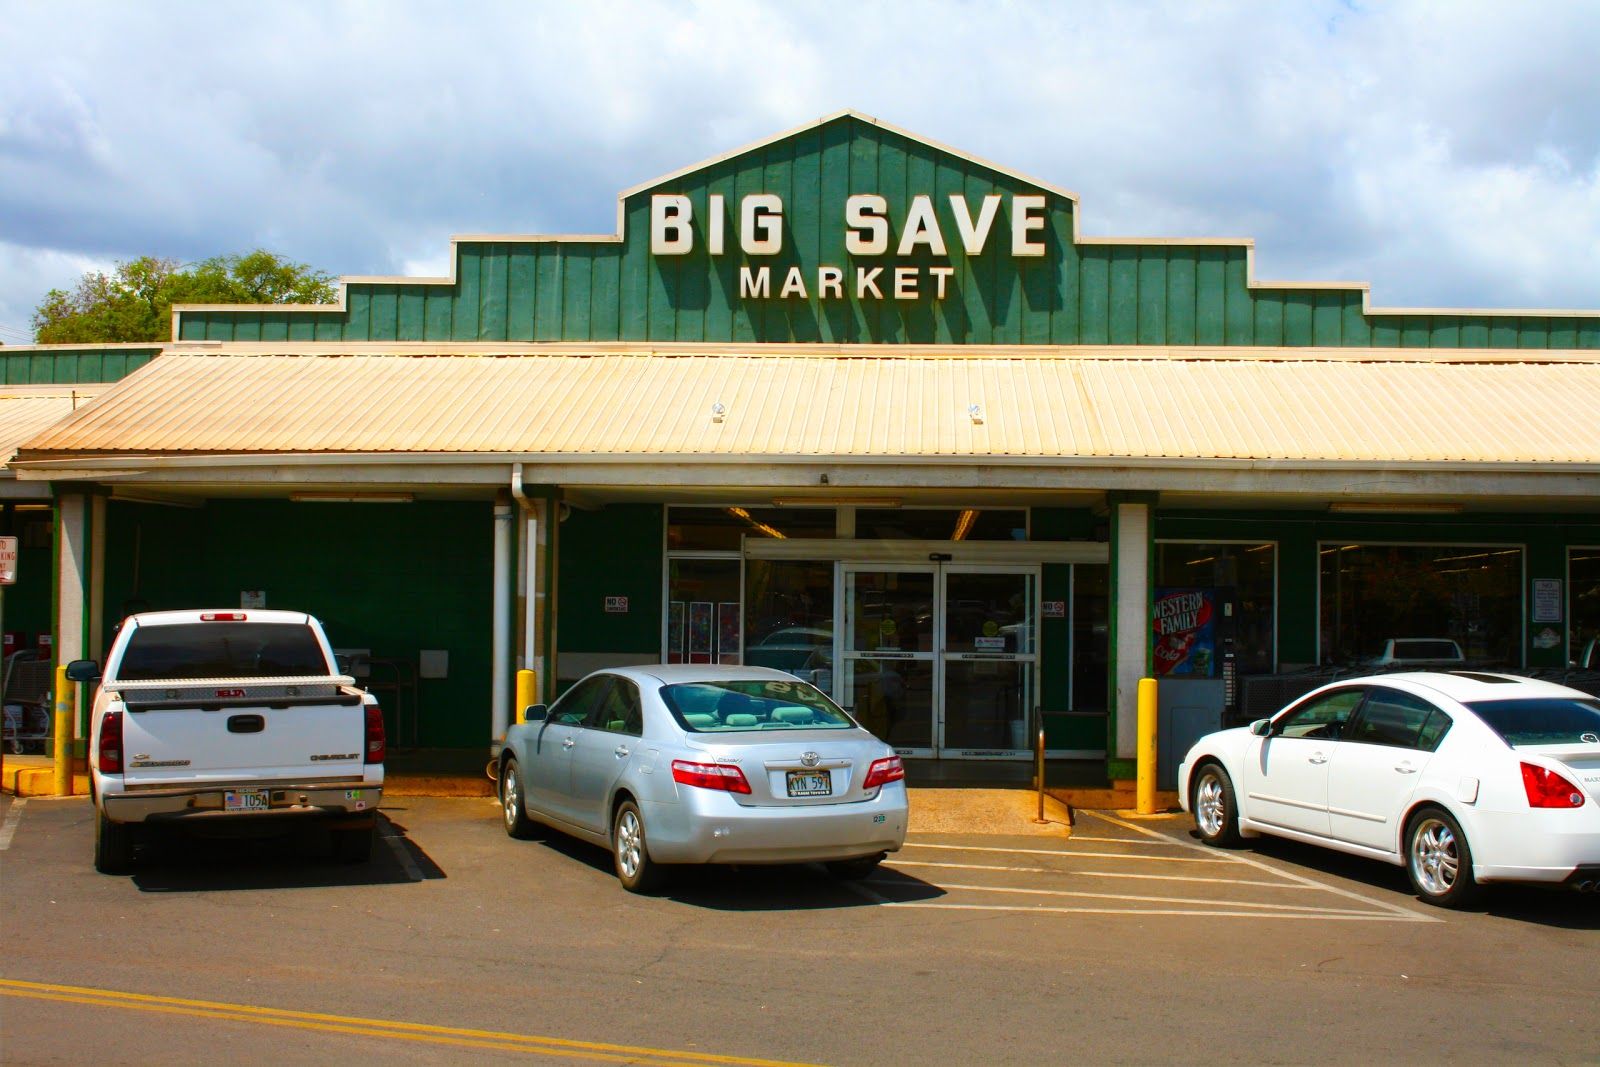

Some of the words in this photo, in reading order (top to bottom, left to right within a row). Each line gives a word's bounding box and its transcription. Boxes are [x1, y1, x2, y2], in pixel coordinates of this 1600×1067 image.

[650, 193, 783, 256] BIG
[845, 193, 1047, 257] SAVE
[739, 266, 955, 300] MARKET
[0, 552, 16, 560] KING
[606, 597, 617, 606] NO
[1041, 602, 1053, 610] NO
[1152, 592, 1204, 619] WESTERN
[1160, 608, 1199, 636] FAMILY
[790, 776, 807, 791] KYN
[244, 794, 268, 807] 105A
